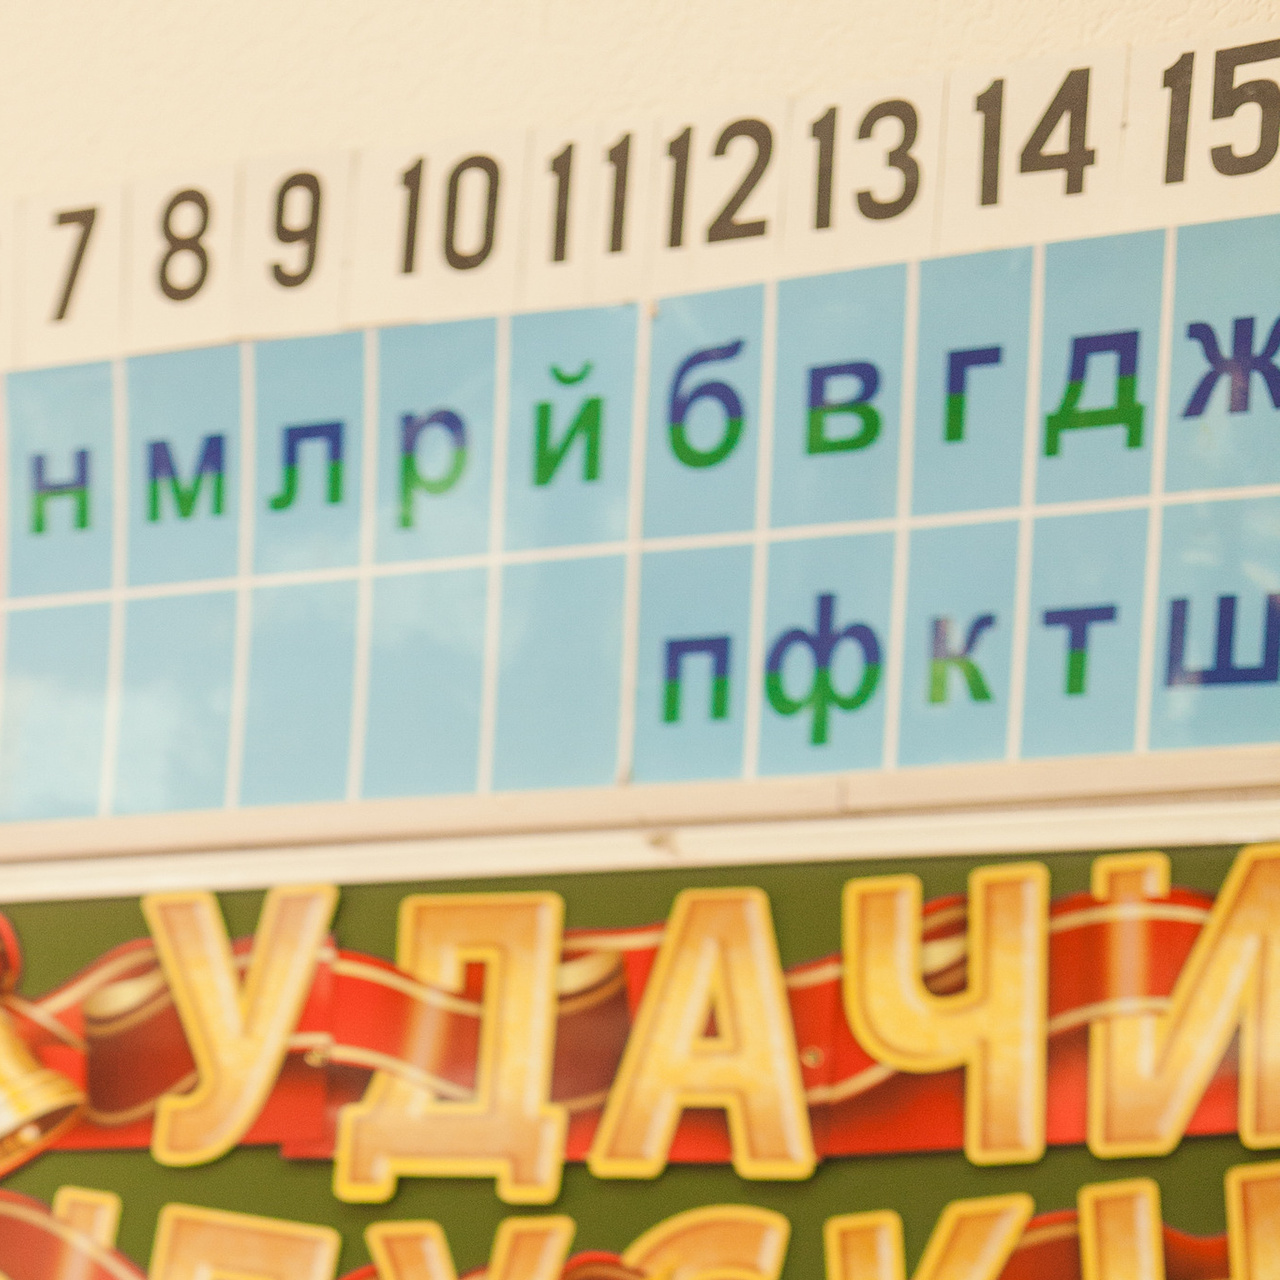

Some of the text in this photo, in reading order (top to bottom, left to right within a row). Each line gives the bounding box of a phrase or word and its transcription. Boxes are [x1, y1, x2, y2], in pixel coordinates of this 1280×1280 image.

[52, 207, 98, 322] 7
[156, 188, 212, 302] 8
[270, 172, 323, 288] 9
[401, 155, 502, 275] 10
[549, 134, 632, 263] 11
[666, 118, 775, 248] 12
[810, 98, 922, 230] 13
[974, 67, 1097, 207] 14
[1161, 38, 1280, 185] 15
[31, 448, 90, 535] н
[146, 433, 226, 522] м
[268, 421, 345, 514] л
[399, 407, 467, 529] р
[534, 361, 603, 487] й
[669, 339, 745, 470] б
[804, 361, 883, 455] в
[945, 344, 1004, 443] г
[1044, 329, 1144, 457] д
[1181, 316, 1280, 420] ж
[662, 635, 731, 724] п
[766, 594, 882, 746] ф
[929, 613, 997, 705] к
[1044, 604, 1116, 696] т
[1167, 593, 1280, 687] ш
[140, 843, 1280, 1204] УДАЧИ
